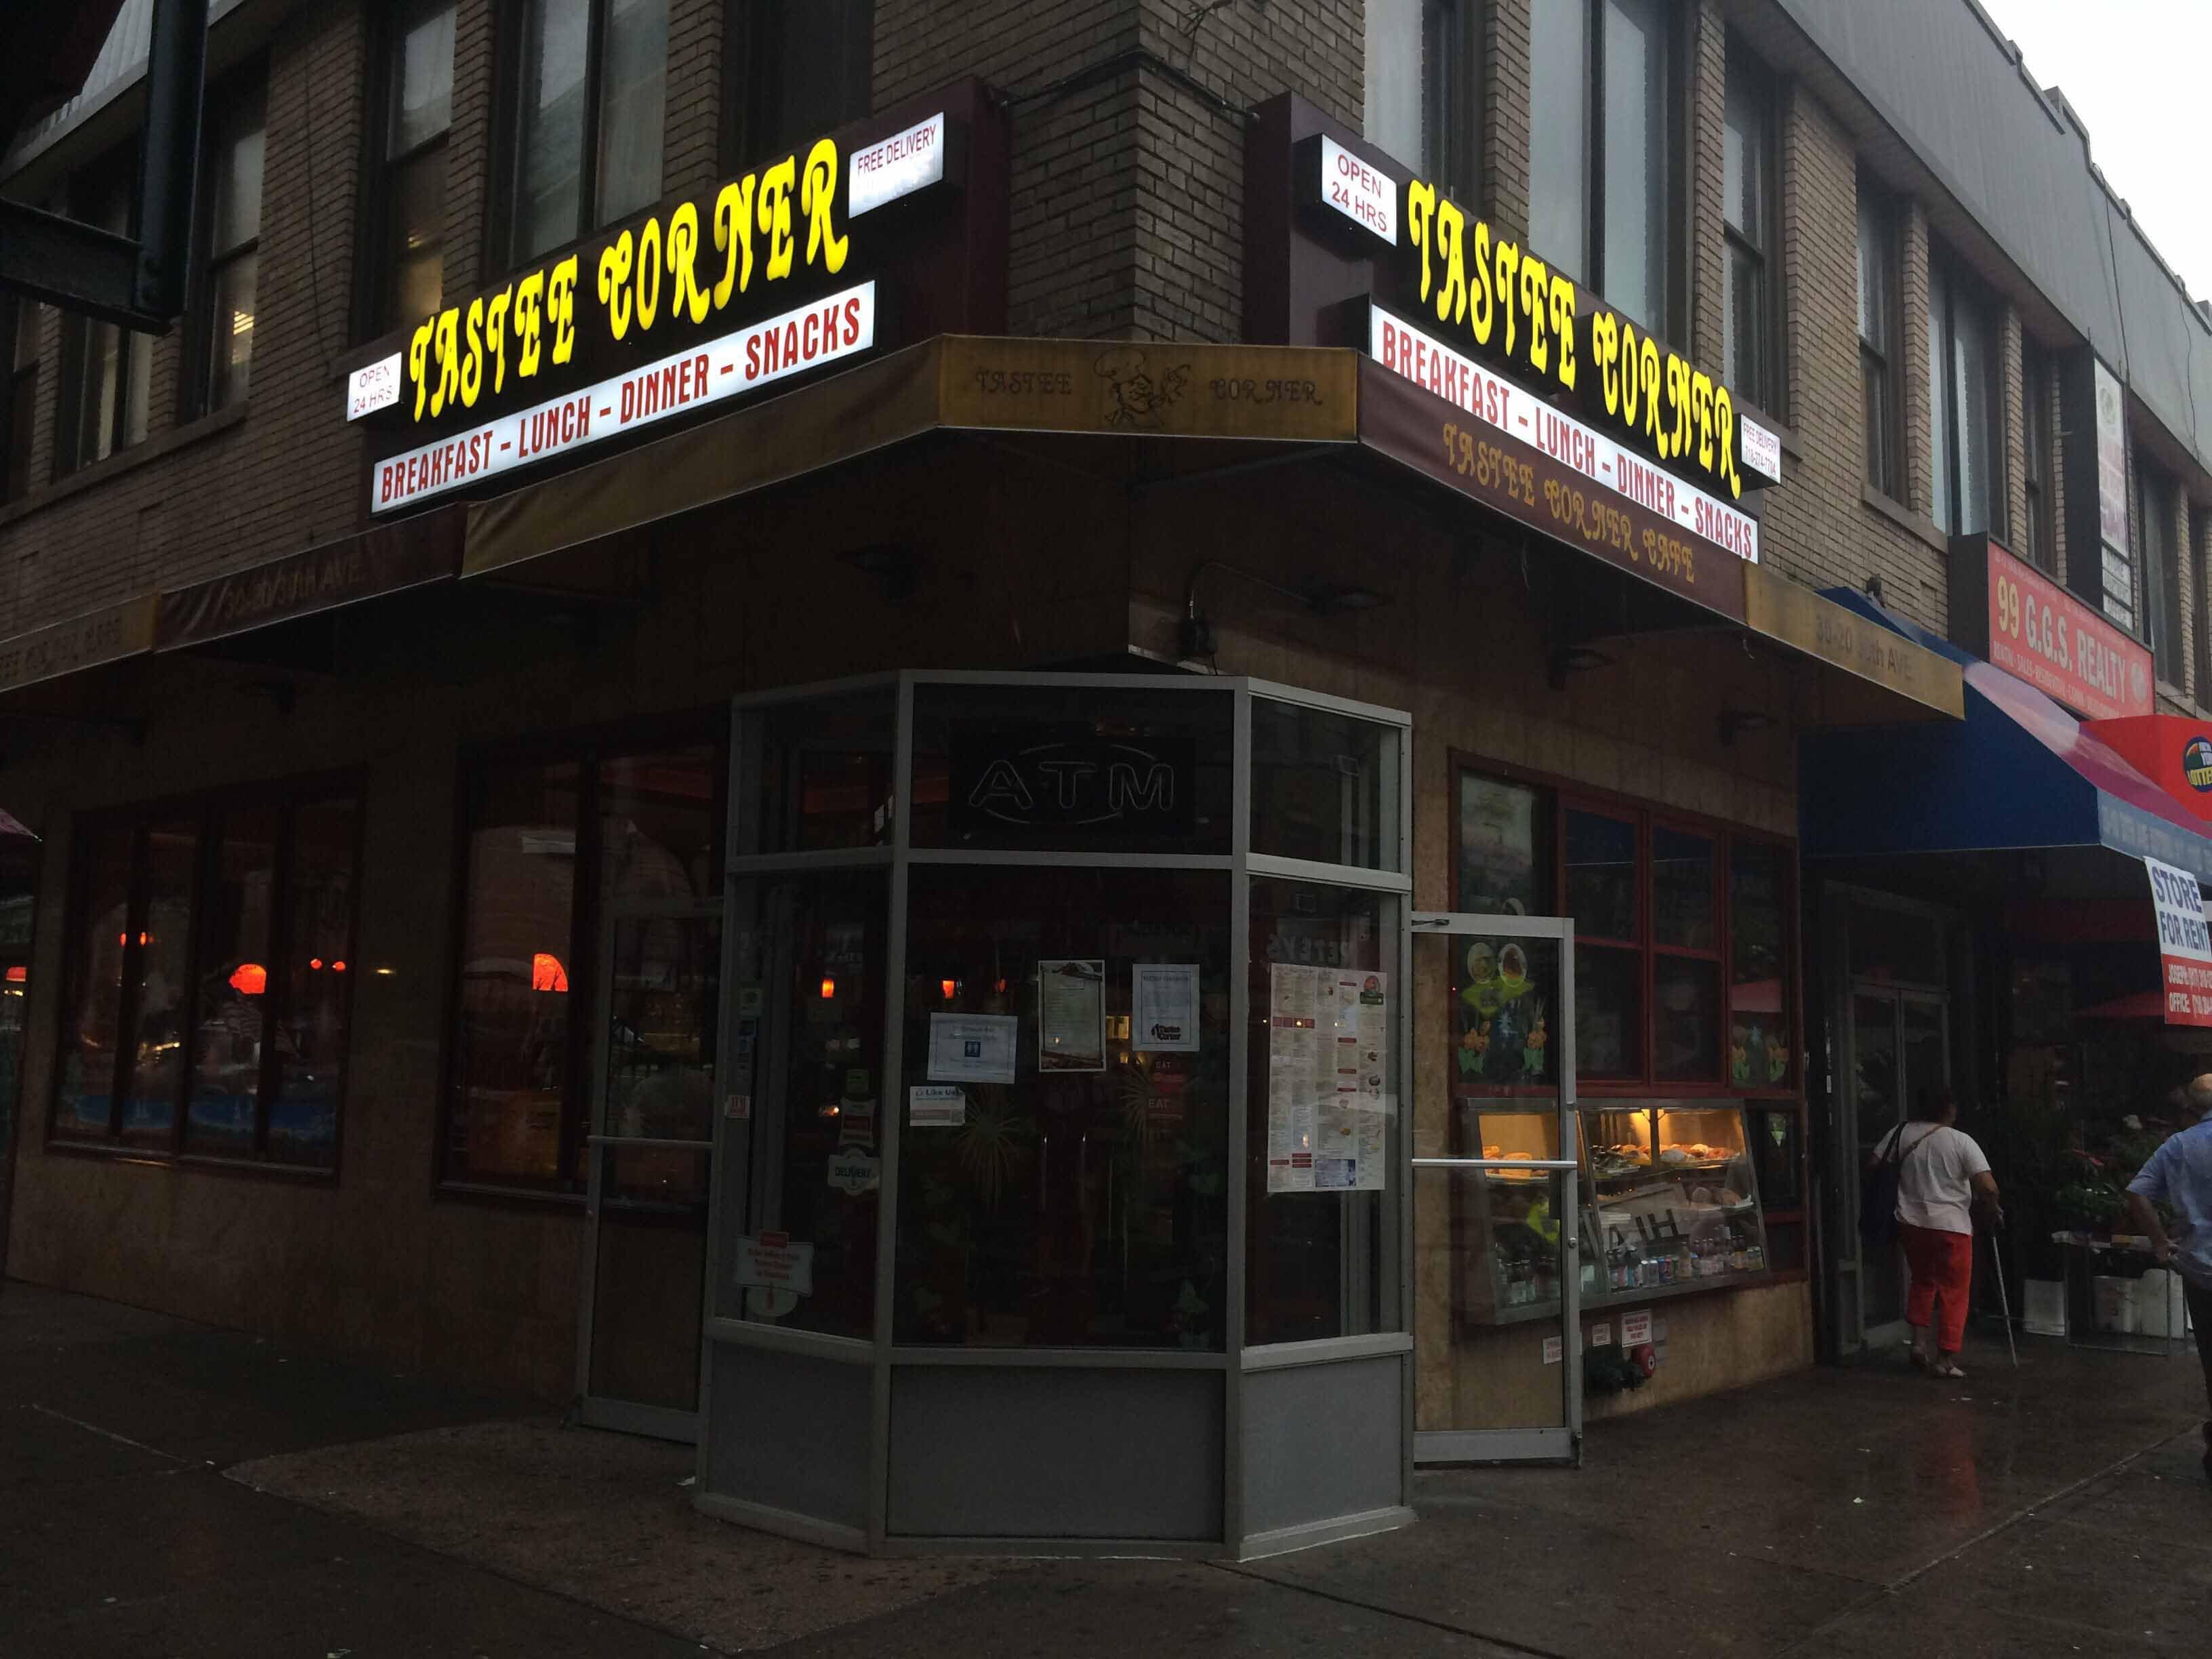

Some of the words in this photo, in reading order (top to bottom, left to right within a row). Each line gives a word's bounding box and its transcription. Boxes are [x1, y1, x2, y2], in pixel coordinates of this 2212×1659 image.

[857, 148, 883, 176] FREE
[886, 123, 937, 161] DELIVERY
[1337, 154, 1382, 199] OPEN
[1332, 181, 1349, 209] 24
[1355, 195, 1387, 232] HRS
[409, 253, 577, 422] TASTEE
[598, 138, 848, 340] CORNER
[1408, 179, 1576, 392] TASTEE
[1593, 311, 1741, 499] CORNER
[354, 397, 366, 414] 24
[370, 385, 392, 409] HRS
[359, 365, 390, 388] OPEN
[381, 430, 493, 504] BREAKFAST
[518, 395, 592, 458] LUNCH
[620, 353, 709, 424] DINNER
[744, 298, 860, 380] SNACKS
[975, 370, 1072, 396] TASTEE
[1208, 378, 1324, 406] CORNER
[1382, 321, 1510, 431] BREAKFAST
[1536, 406, 1595, 478] LUNCH
[1617, 453, 1675, 520] DINNER
[1695, 496, 1753, 560] SNACKS
[1442, 423, 1535, 507] TASTEE
[1543, 478, 1639, 561] CORNER
[1642, 527, 1694, 583] CAFE
[1997, 575, 2020, 640] 99
[2025, 593, 2073, 673] G.G.S.
[2076, 628, 2126, 705] REALTY
[968, 758, 1176, 812] ATM
[2151, 865, 2203, 914] STORE
[2159, 910, 2184, 947] FOR
[2184, 916, 2212, 953] RENT
